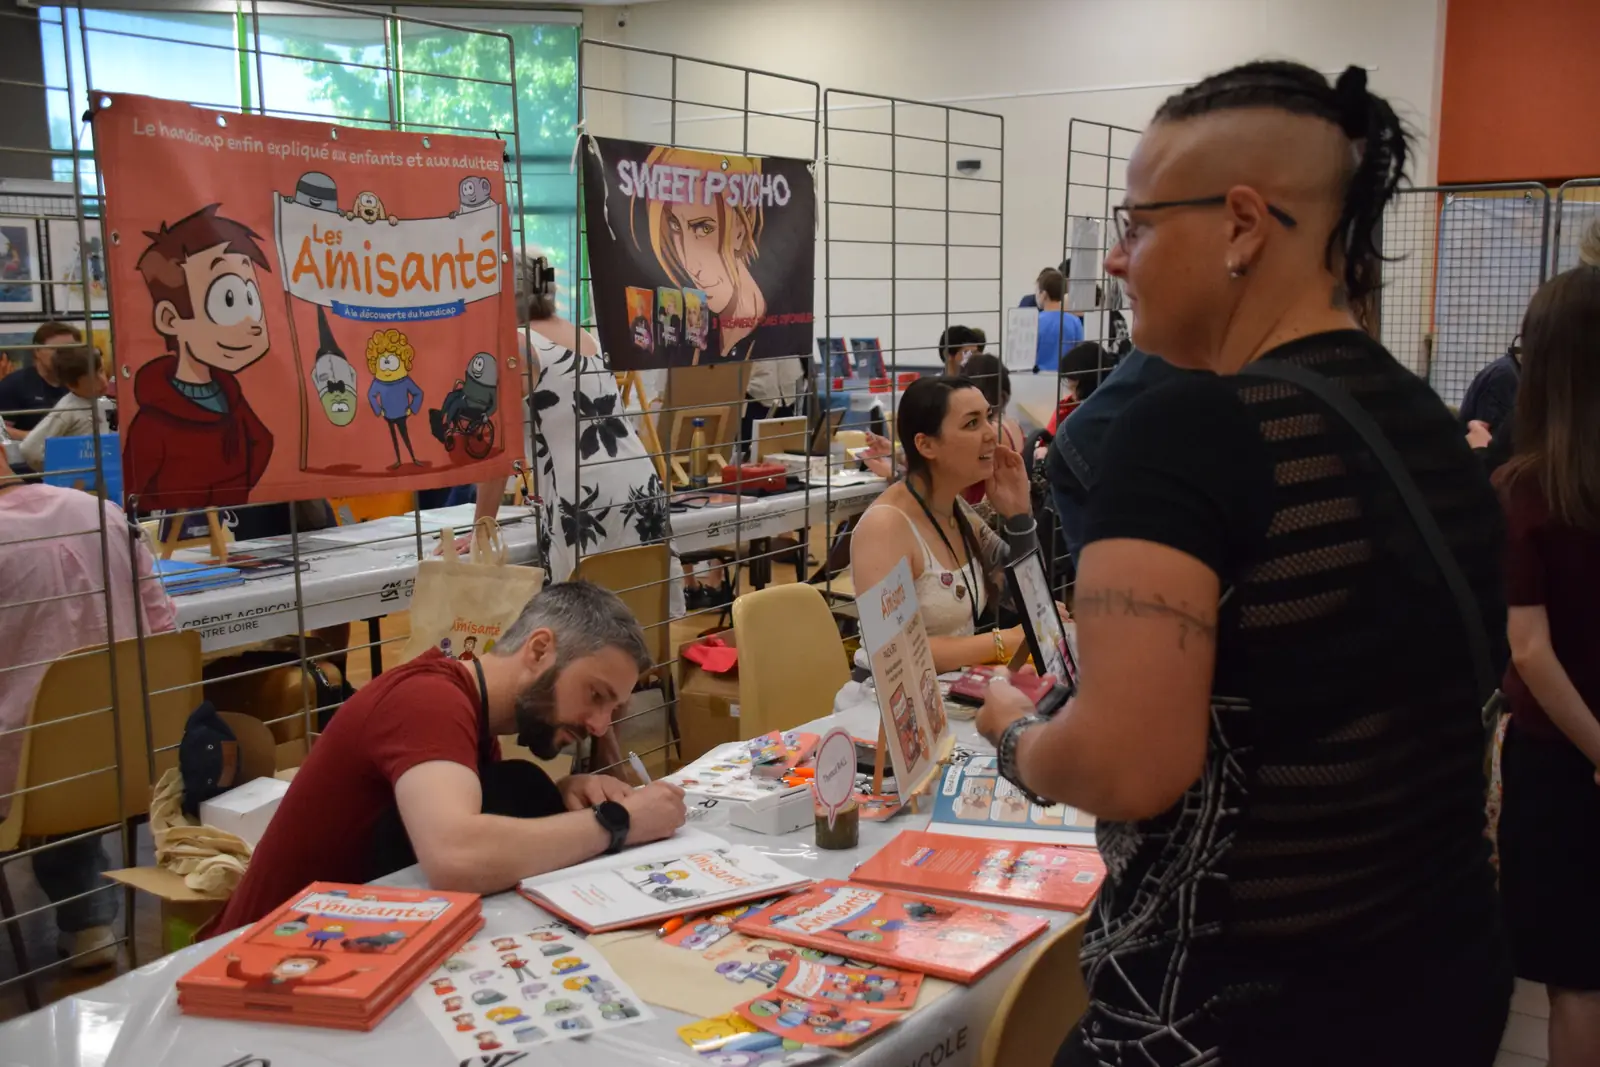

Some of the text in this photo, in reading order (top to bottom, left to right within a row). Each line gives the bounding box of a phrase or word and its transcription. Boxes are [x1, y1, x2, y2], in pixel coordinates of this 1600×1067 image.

[133, 118, 500, 172] Le handicap enfin expliqué aux enfants et aux adultes
[616, 159, 791, 207] SWEET PSYCHO
[313, 223, 343, 246] Les
[292, 230, 497, 298] Amisanté
[360, 308, 406, 320] découverte
[407, 309, 418, 318] du
[419, 306, 456, 317] handicap
[200, 620, 260, 639] NTRE LOIRE
[301, 900, 440, 918] Amisanté
